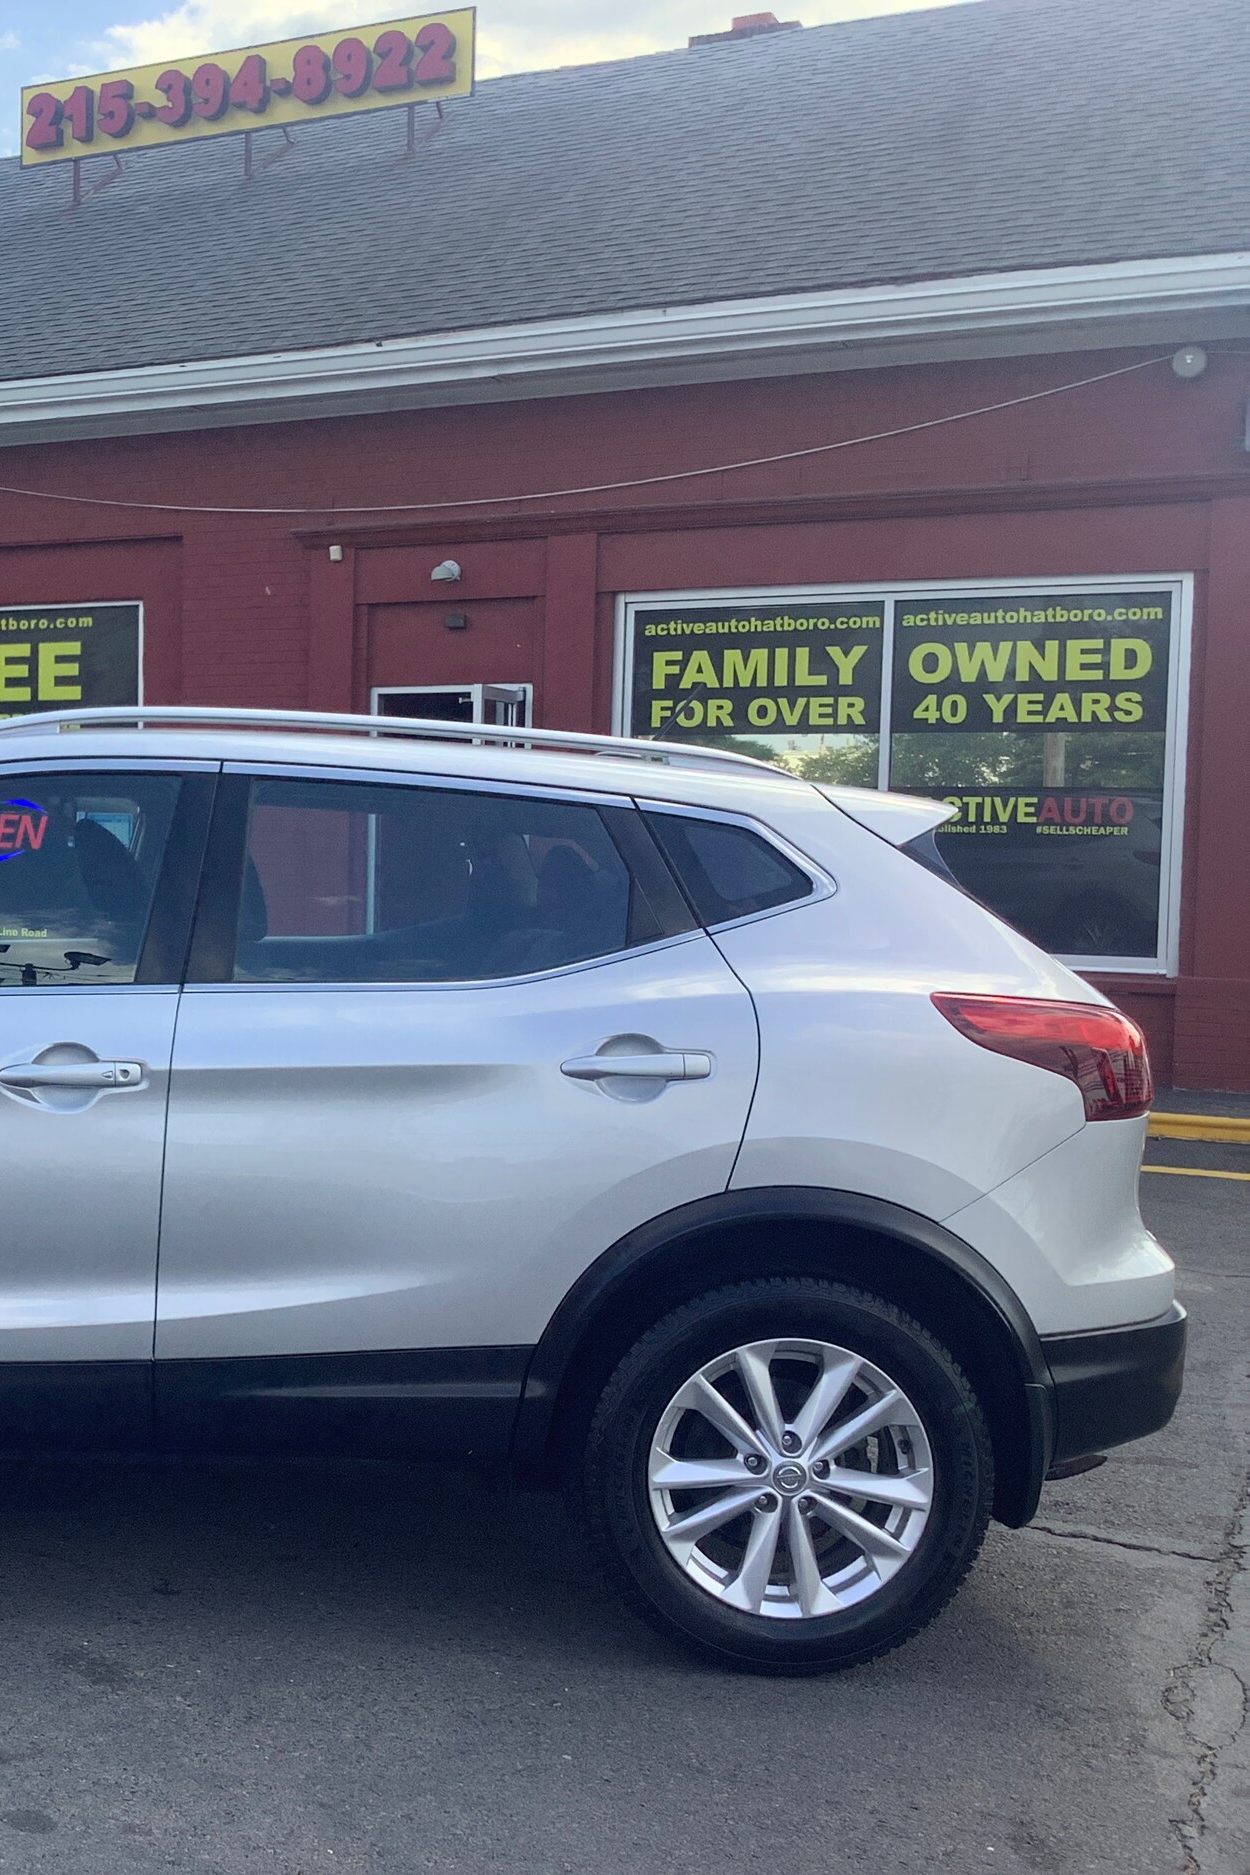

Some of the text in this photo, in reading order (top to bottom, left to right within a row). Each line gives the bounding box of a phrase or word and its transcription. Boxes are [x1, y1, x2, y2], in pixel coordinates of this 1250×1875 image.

[26, 22, 456, 150] 215-394-8922
[645, 613, 881, 636] activeautohatboro.com
[902, 605, 1164, 626] activeautohatboro.com
[651, 637, 1152, 690] FAMILY OWNED
[650, 691, 1144, 728] FOR OVER 40 YEARS
[942, 796, 1134, 824] CTIVEAUTO
[979, 825, 1007, 834] 1983
[1036, 826, 1129, 836] #SELLSCHEAPER
[21, 928, 48, 938] Road
